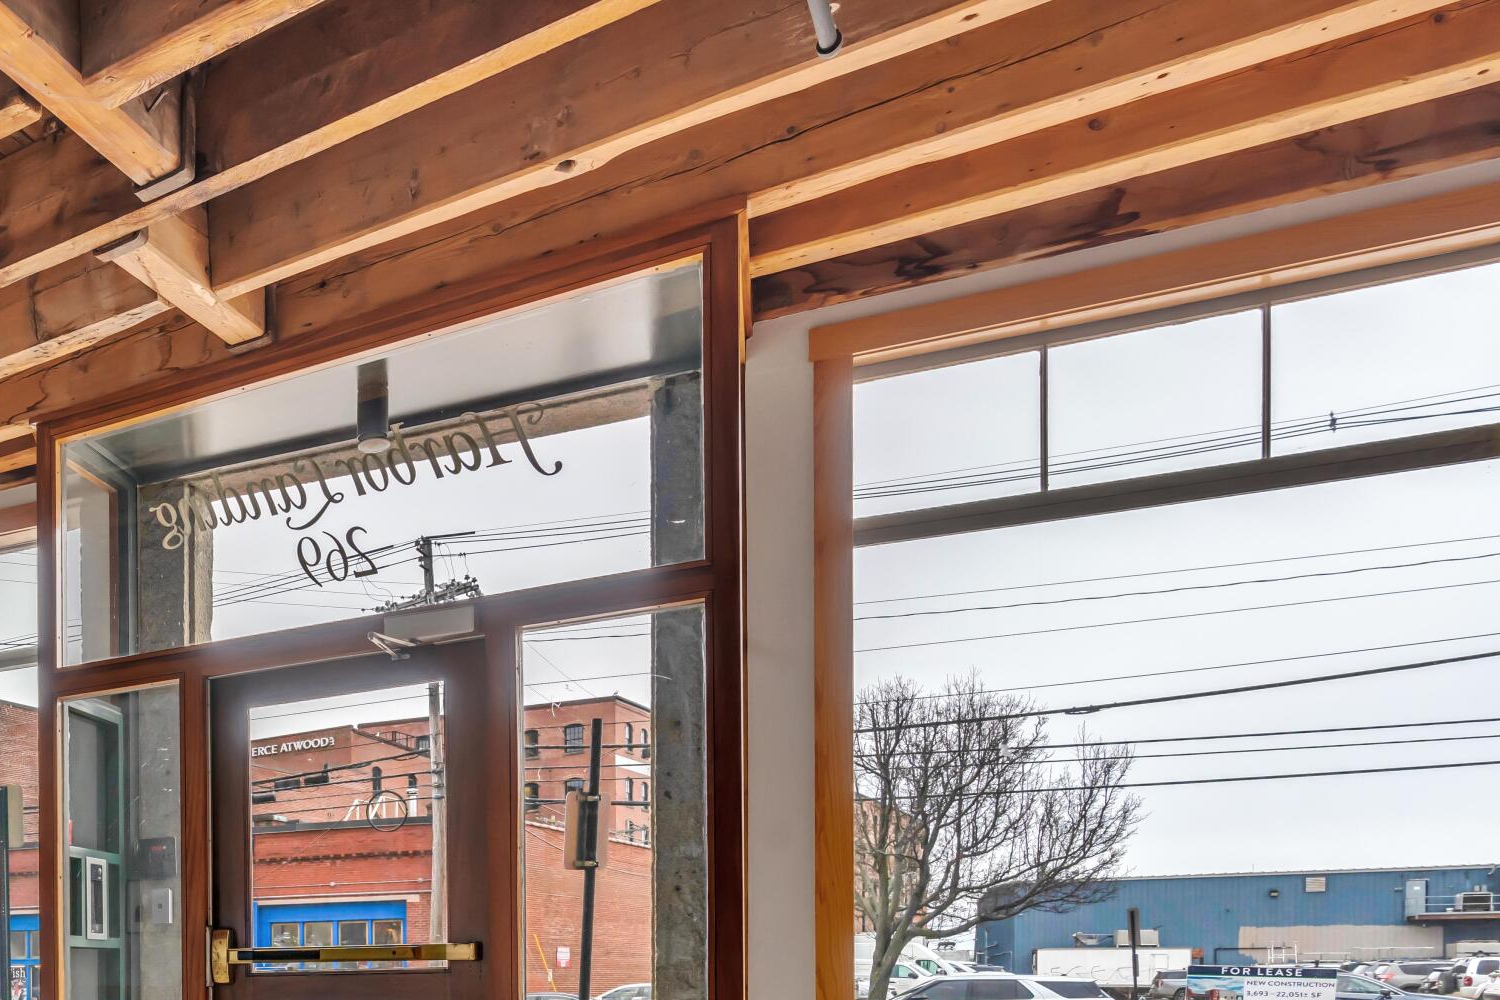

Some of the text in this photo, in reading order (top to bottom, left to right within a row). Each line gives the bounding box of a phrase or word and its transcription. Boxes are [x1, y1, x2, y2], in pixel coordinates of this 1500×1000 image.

[280, 737, 329, 752] ATWOOD
[1221, 967, 1303, 977] FOR LEASE
[1267, 980, 1335, 988] CONSTRUCTION
